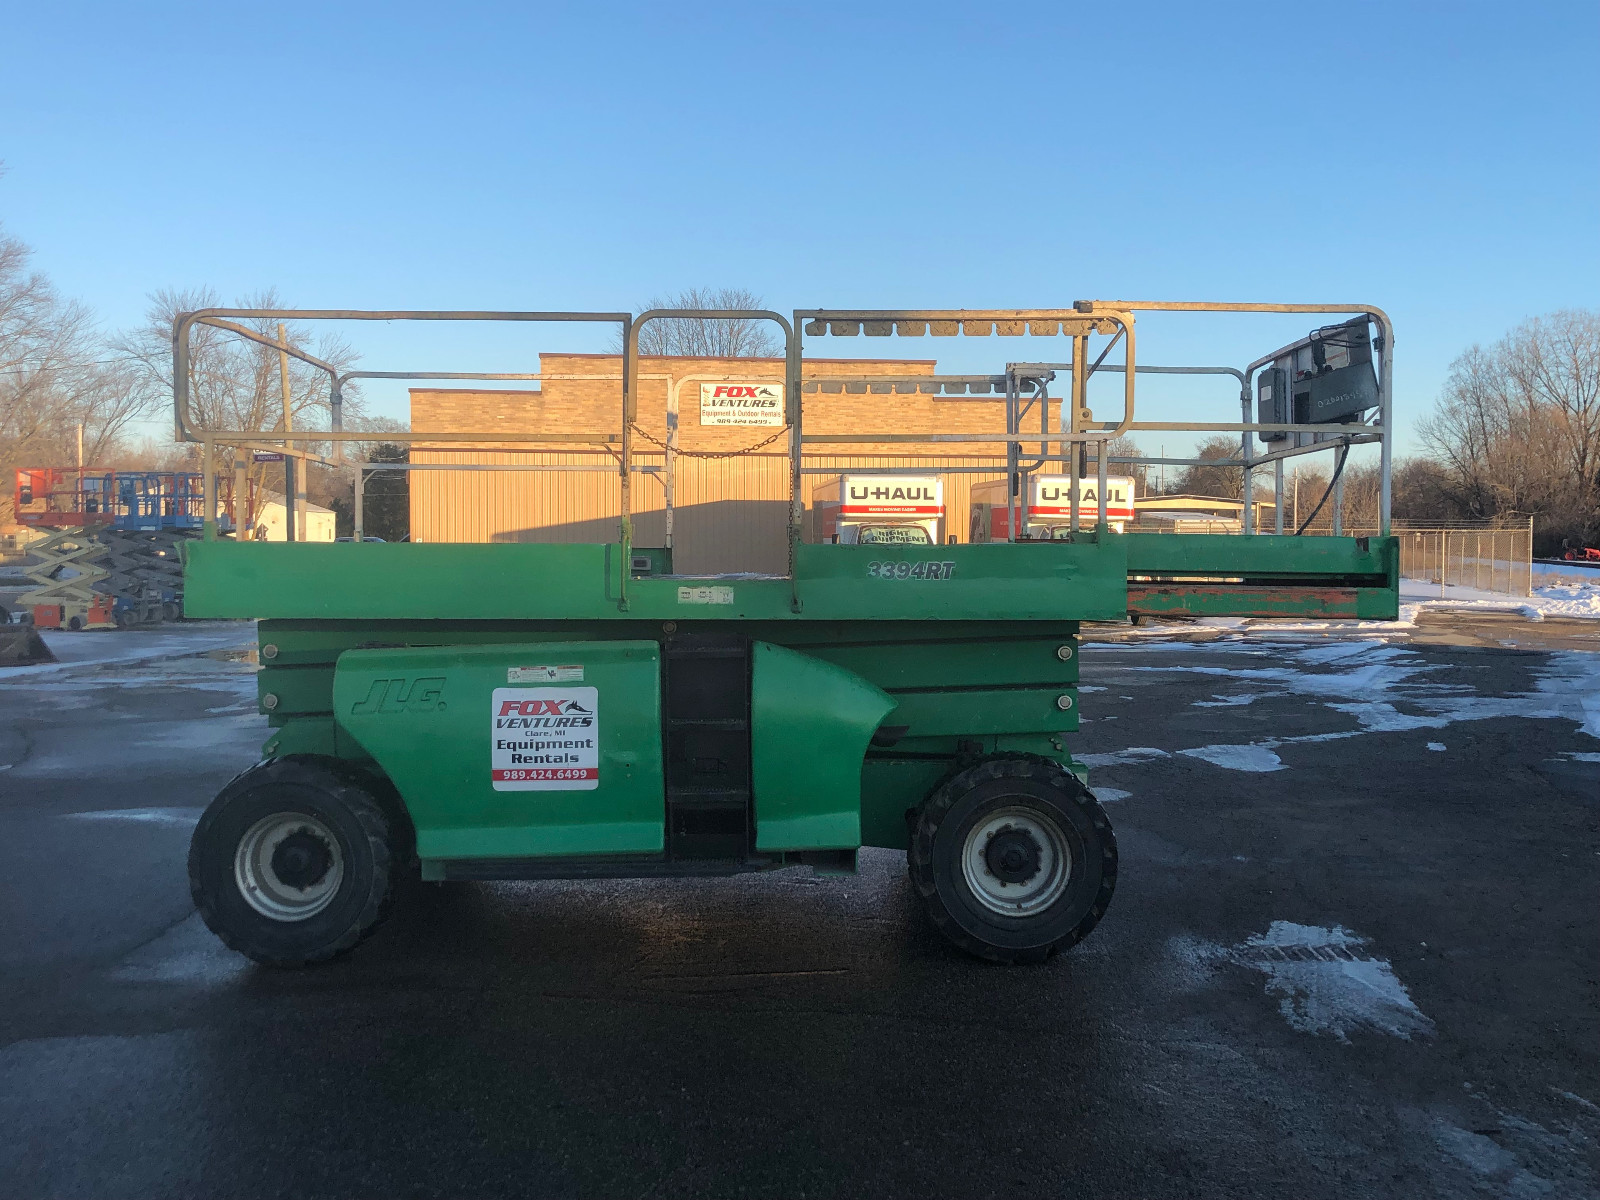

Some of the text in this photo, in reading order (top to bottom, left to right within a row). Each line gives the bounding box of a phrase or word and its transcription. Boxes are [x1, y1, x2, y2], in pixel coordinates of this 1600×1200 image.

[713, 386, 761, 397] FOX
[712, 399, 777, 408] VENTURES
[702, 410, 731, 418] Equipment
[760, 410, 782, 418] Rentals
[850, 486, 935, 501] U-HAUL
[878, 529, 911, 537] RIGHT
[866, 560, 956, 581] 3394RT
[498, 699, 570, 716] FOX
[496, 717, 593, 729] VENTURES
[497, 739, 594, 752] Equipment
[511, 753, 579, 764] Rentals
[503, 769, 587, 780] 989.424.6499
